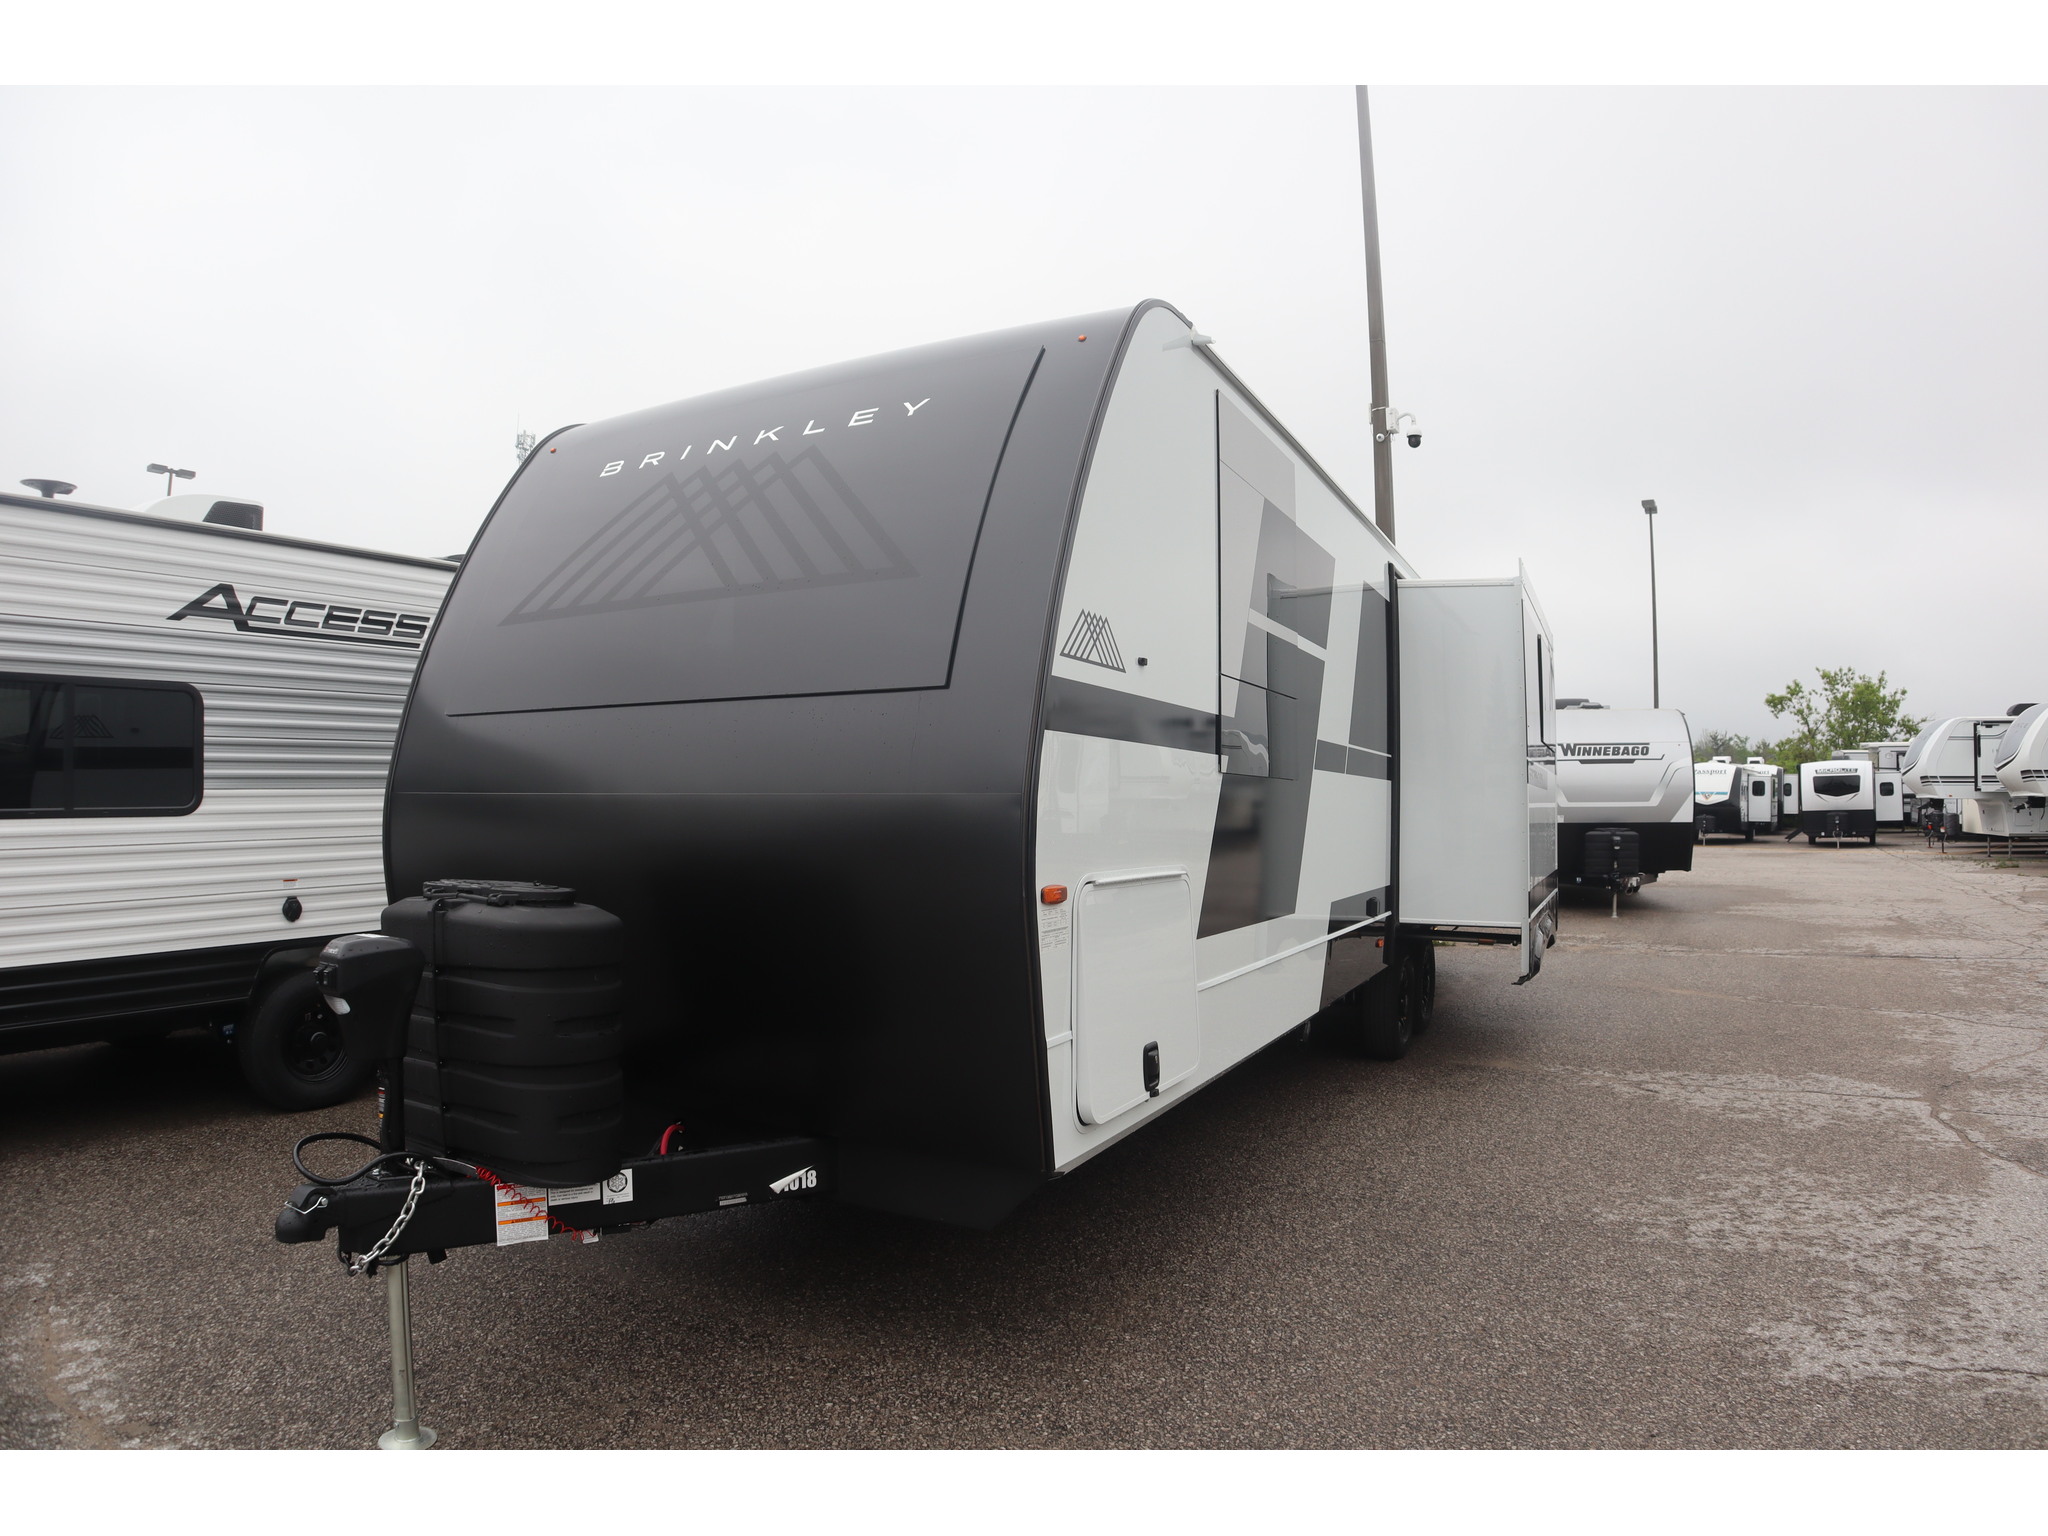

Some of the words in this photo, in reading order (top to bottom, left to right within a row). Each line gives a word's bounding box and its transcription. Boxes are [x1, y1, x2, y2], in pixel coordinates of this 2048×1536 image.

[599, 397, 931, 478] BRINKLEY
[166, 583, 431, 640] ACCESS
[1559, 743, 1650, 757] WINNEBAGO
[783, 1168, 818, 1192] 018
